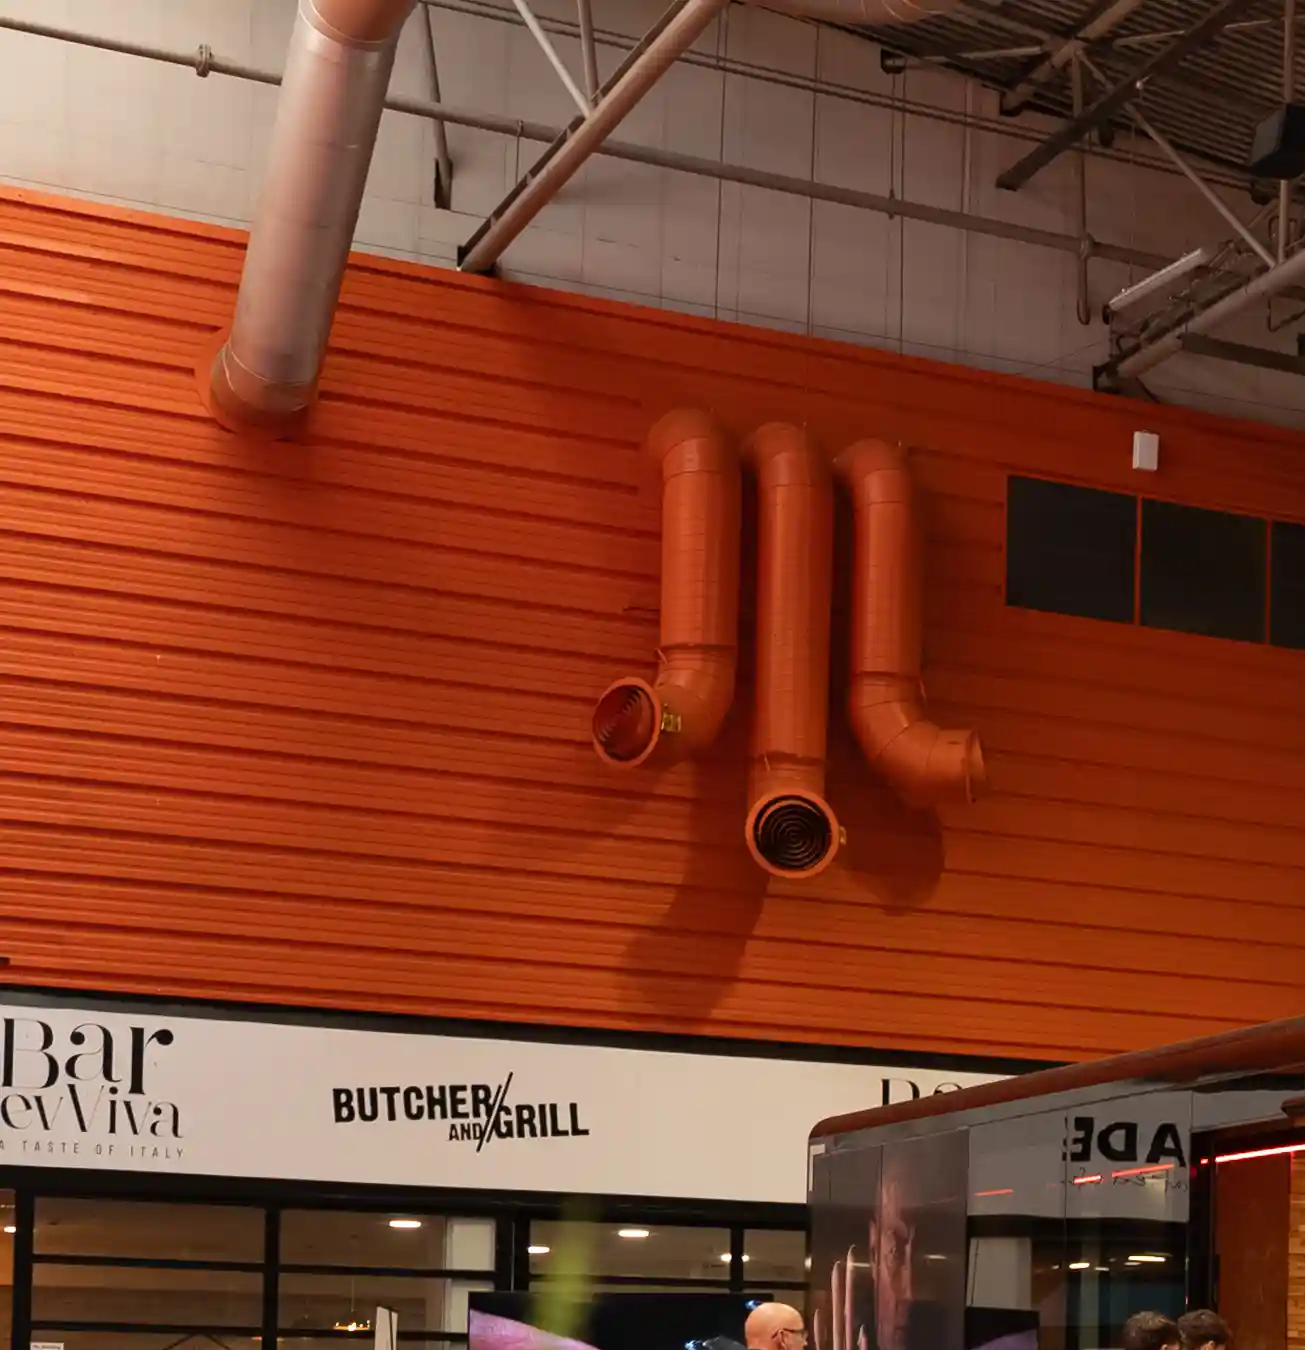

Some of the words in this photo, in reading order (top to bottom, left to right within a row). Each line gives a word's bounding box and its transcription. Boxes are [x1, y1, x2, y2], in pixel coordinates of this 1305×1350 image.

[2, 1018, 174, 1095] Bar
[1, 1083, 185, 1139] evViva
[333, 1084, 494, 1123] BUTCHER
[494, 1102, 590, 1139] GRILL
[22, 1140, 80, 1154] TASTE
[96, 1144, 115, 1156] OF
[130, 1147, 185, 1159] ITALY
[449, 1122, 484, 1141] AND
